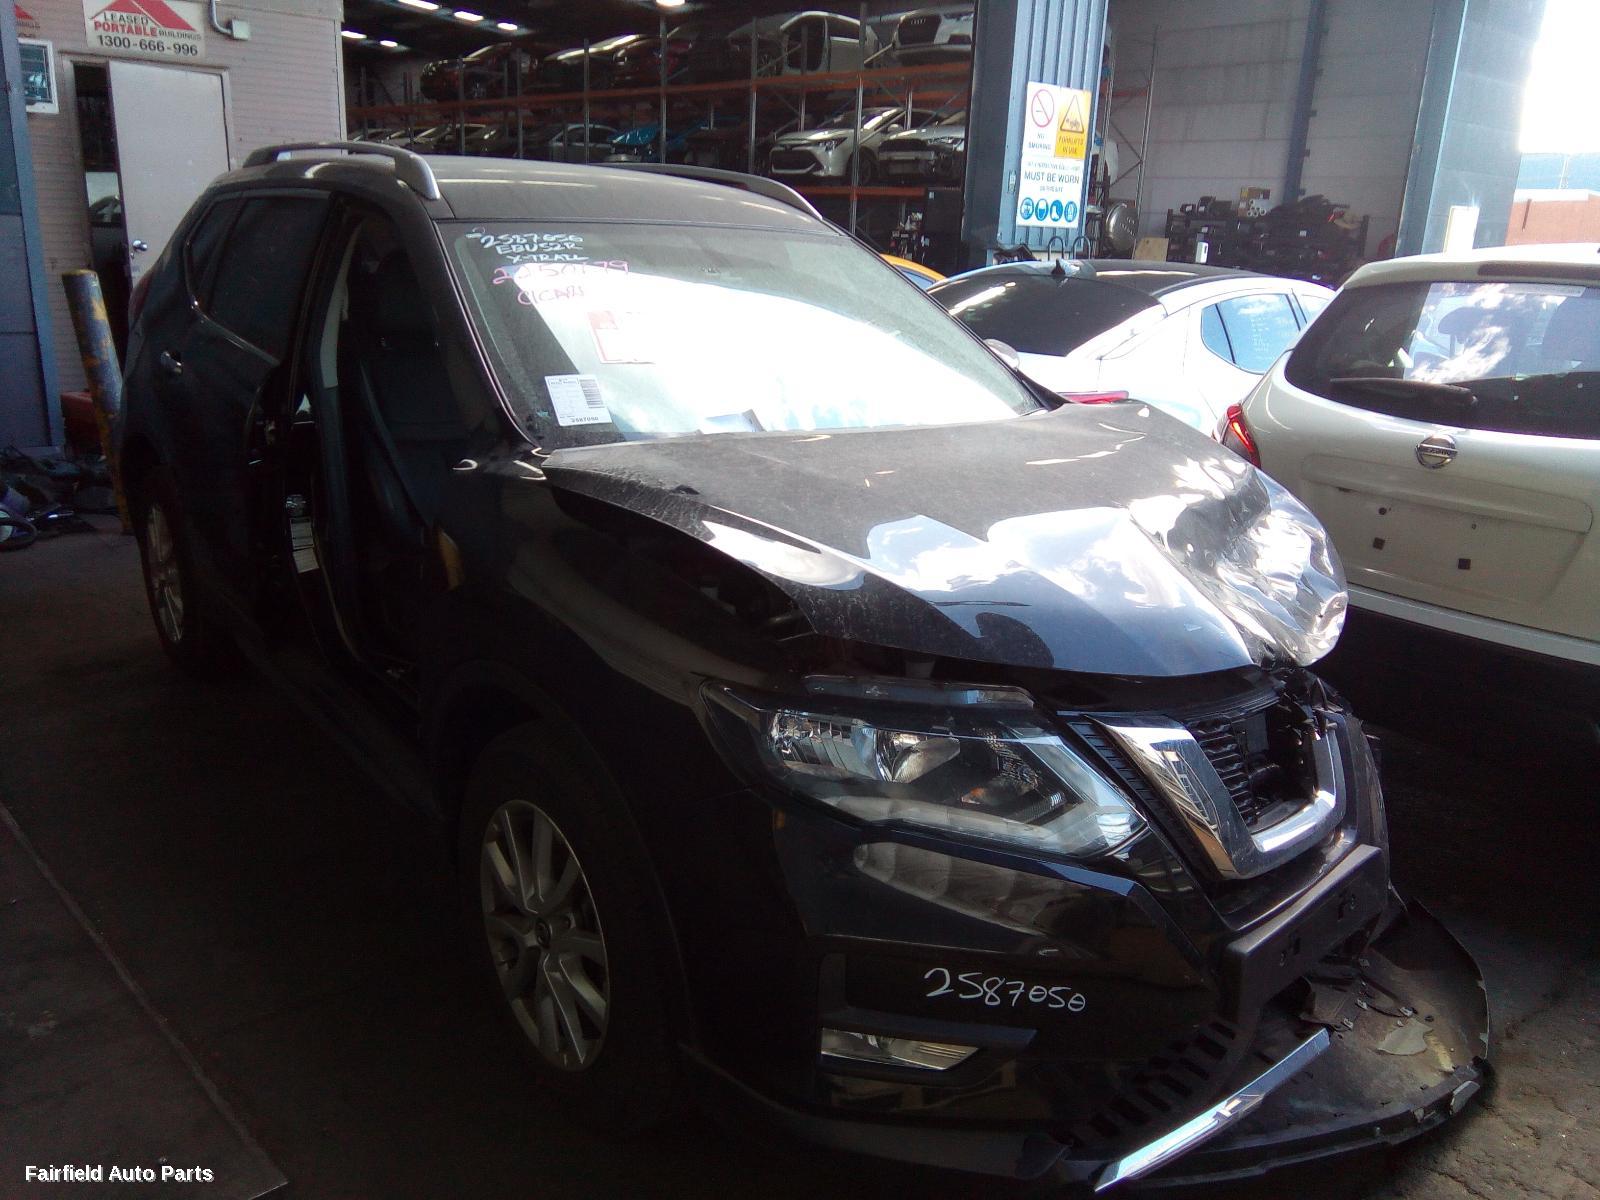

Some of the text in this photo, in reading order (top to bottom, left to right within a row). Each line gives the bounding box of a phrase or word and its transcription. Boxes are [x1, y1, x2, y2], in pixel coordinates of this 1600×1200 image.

[103, 12, 149, 25] LEASED
[94, 21, 202, 40] PORTABLE BUILDINGS
[98, 35, 198, 56] 1300-666-996
[1024, 171, 1080, 184] MUST BE WORN
[924, 967, 1086, 1012] 2587050
